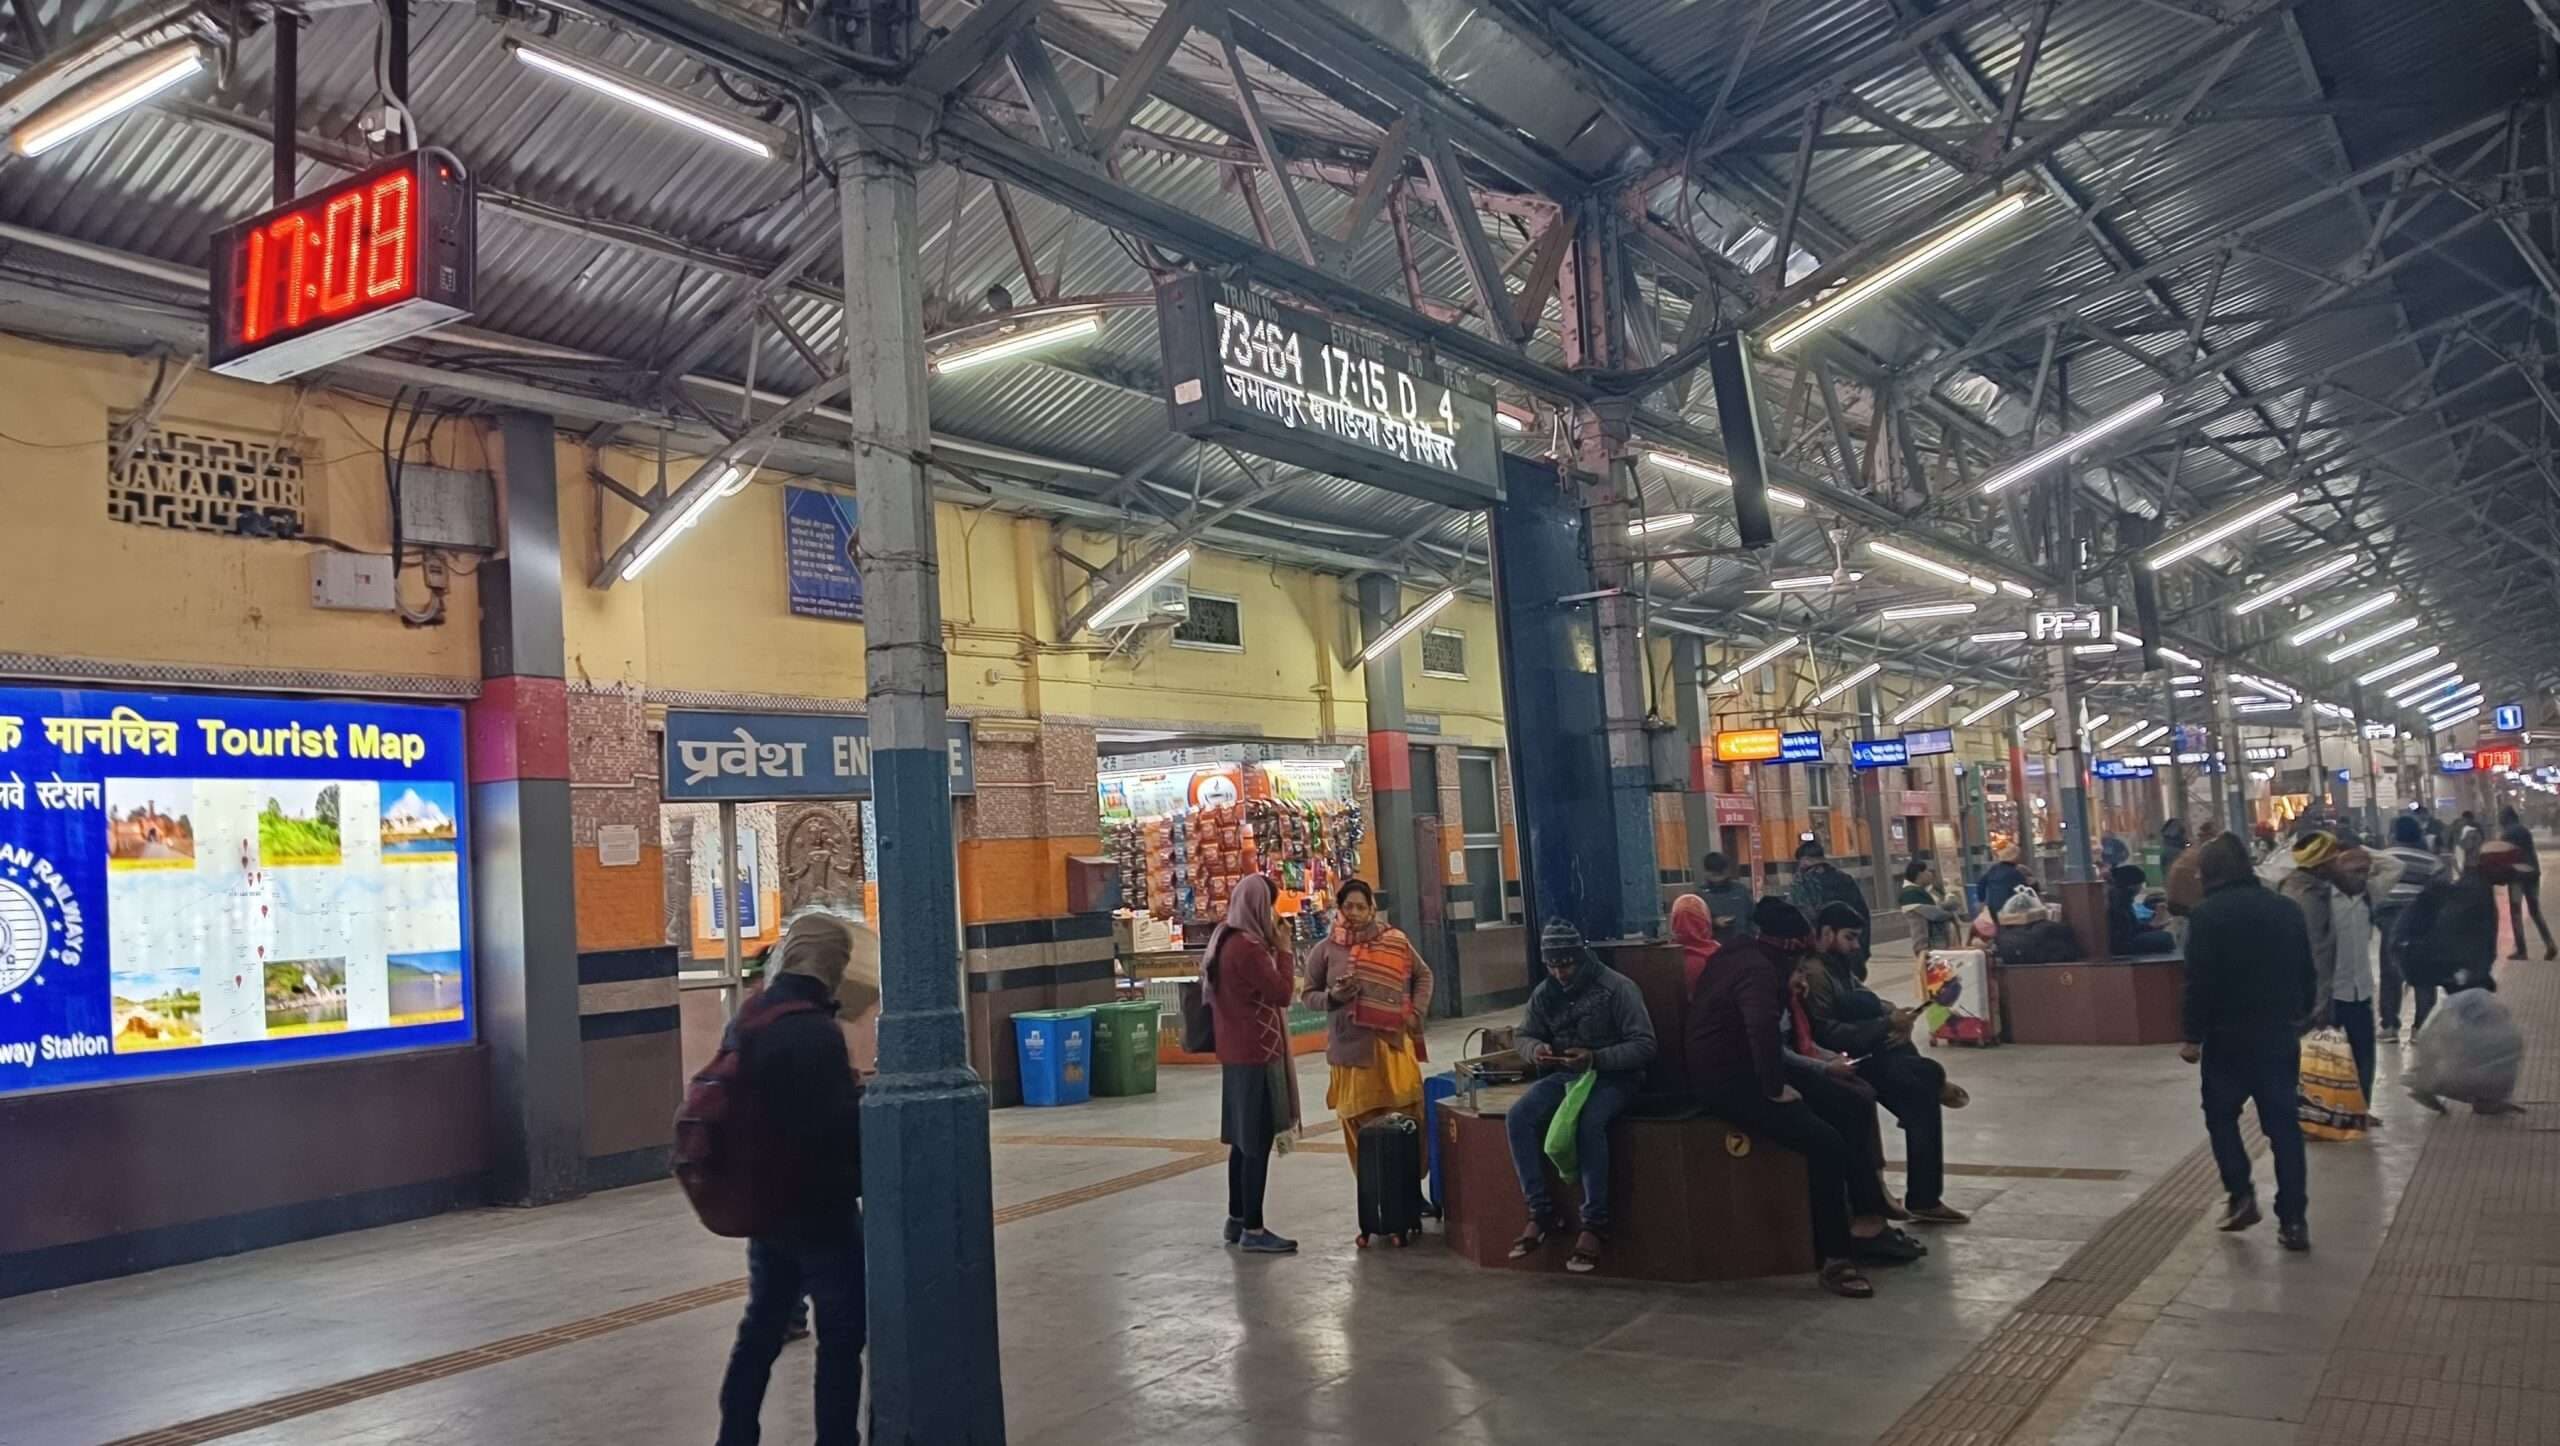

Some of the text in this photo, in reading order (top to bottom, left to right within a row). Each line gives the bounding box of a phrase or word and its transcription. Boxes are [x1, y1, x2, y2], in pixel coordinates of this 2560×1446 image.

[1214, 302, 1454, 435] 73464 17:15 D 4
[109, 463, 300, 507] JAMALPUR
[2036, 610, 2101, 640] PF-1
[41, 706, 179, 756] मानचित्र
[197, 719, 425, 768] Tourist Map
[677, 727, 807, 786] प्रवेश
[34, 771, 101, 810] स्टेशन
[40, 1031, 109, 1060] Station
